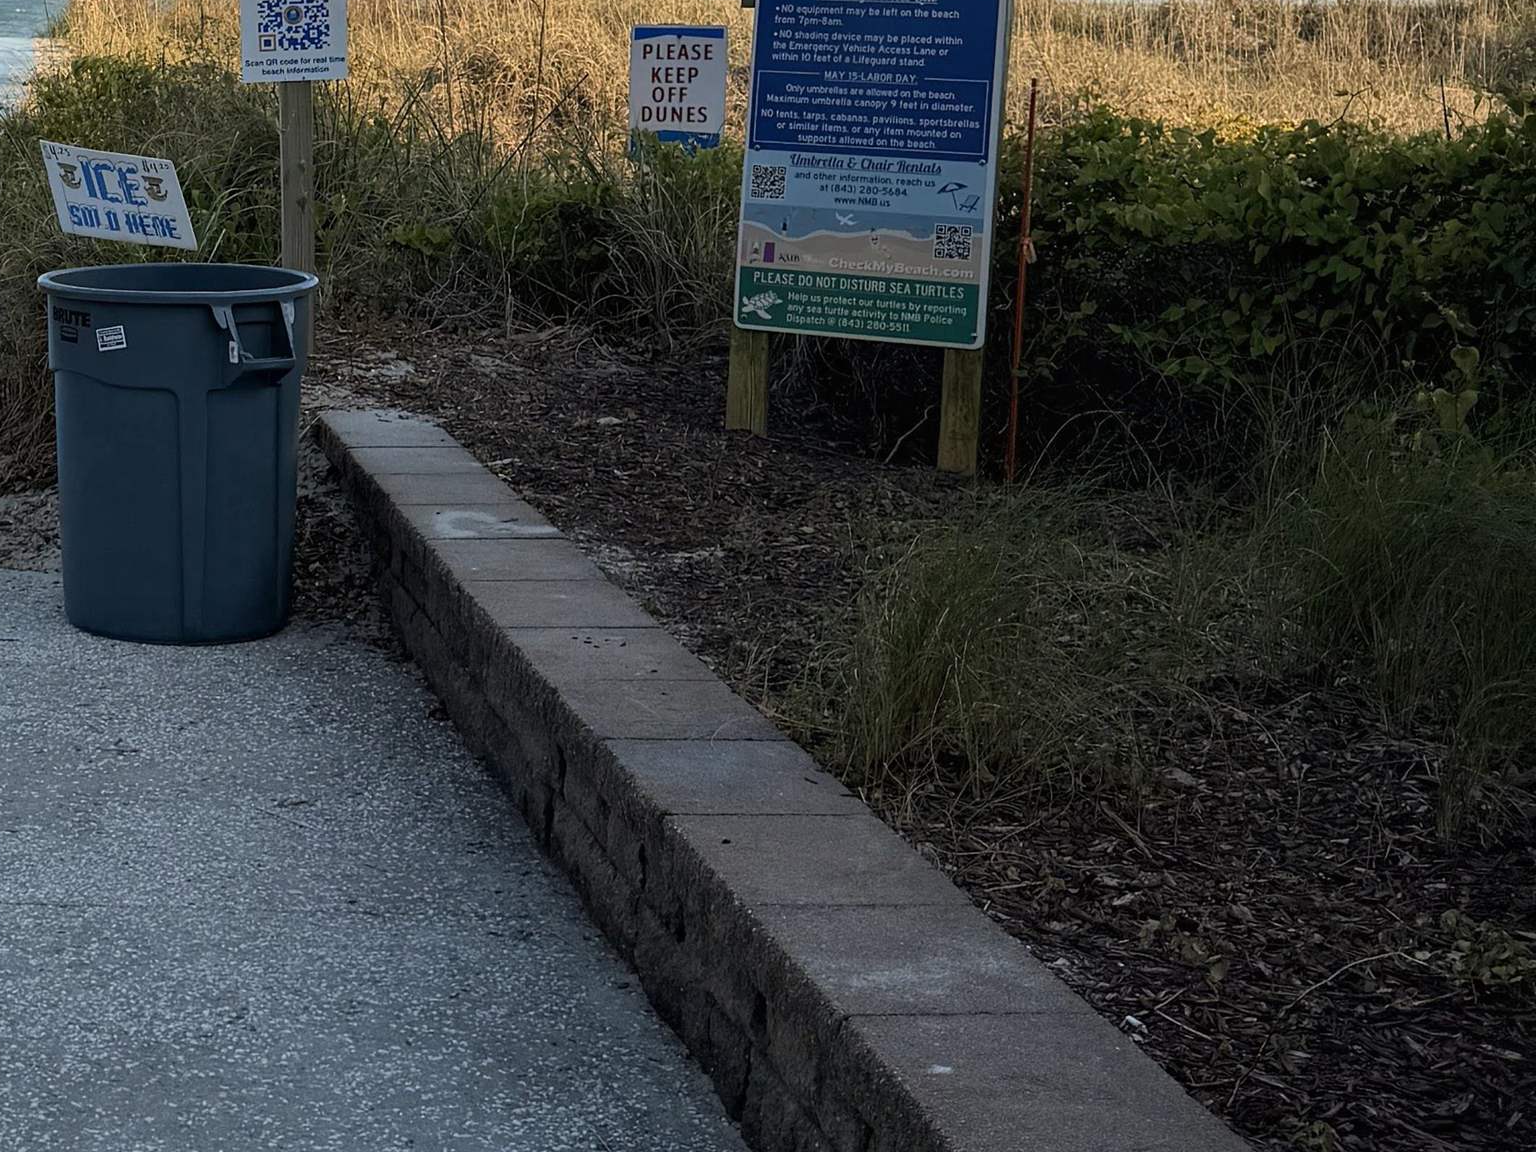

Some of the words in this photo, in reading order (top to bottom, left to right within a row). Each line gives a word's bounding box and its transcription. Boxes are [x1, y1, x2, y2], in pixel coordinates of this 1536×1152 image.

[781, 4, 794, 13] NO
[796, 5, 843, 16] equipment
[846, 8, 866, 18] may
[869, 7, 880, 16] be
[883, 7, 898, 17] left
[900, 9, 912, 17] on
[914, 8, 929, 18] the
[775, 16, 795, 24] from
[779, 30, 792, 38] NO
[795, 30, 829, 42] shading
[831, 32, 862, 41] device
[864, 34, 884, 44] may
[887, 34, 899, 43] be
[901, 35, 932, 45] placed
[934, 36, 963, 45] within
[642, 43, 713, 60] PLEASE
[245, 59, 264, 67] Scan
[266, 58, 278, 66] QR
[300, 57, 311, 65] for
[313, 56, 328, 64] real
[262, 68, 285, 76] beach
[286, 66, 330, 75] information
[651, 67, 699, 84] KEEP
[652, 86, 688, 103] OFF
[642, 106, 708, 123] DUNES
[790, 153, 845, 168] Umbrella
[847, 157, 858, 168] &
[861, 158, 895, 172] Chair
[897, 160, 942, 174] Rentals
[77, 155, 149, 207] ICE
[794, 171, 811, 180] and
[813, 172, 836, 181] other
[896, 177, 923, 187] reach
[924, 179, 936, 187] us
[819, 184, 828, 192] at
[830, 184, 856, 194] (843)
[754, 271, 795, 285] PLEASE
[798, 275, 812, 286] DO
[816, 276, 838, 288] NOT
[840, 278, 886, 293] DISTURB
[889, 281, 911, 295] SEA
[915, 284, 964, 299] TURTLES
[787, 292, 808, 302] Help
[810, 294, 821, 302] us
[824, 295, 856, 305] protect
[858, 299, 873, 307] our
[876, 299, 906, 309] turtles
[909, 301, 921, 312] by
[924, 304, 967, 316] reporting
[53, 305, 91, 327] BRUTE
[787, 305, 803, 314] any
[807, 306, 822, 314] sea
[824, 306, 849, 316] turtle
[852, 307, 886, 320] activity
[890, 311, 899, 320] to
[901, 312, 921, 322] NMB
[924, 314, 953, 325] Police
[787, 314, 825, 325] Dispatch
[838, 317, 864, 328] (843)
[866, 320, 910, 332] 280-5511
